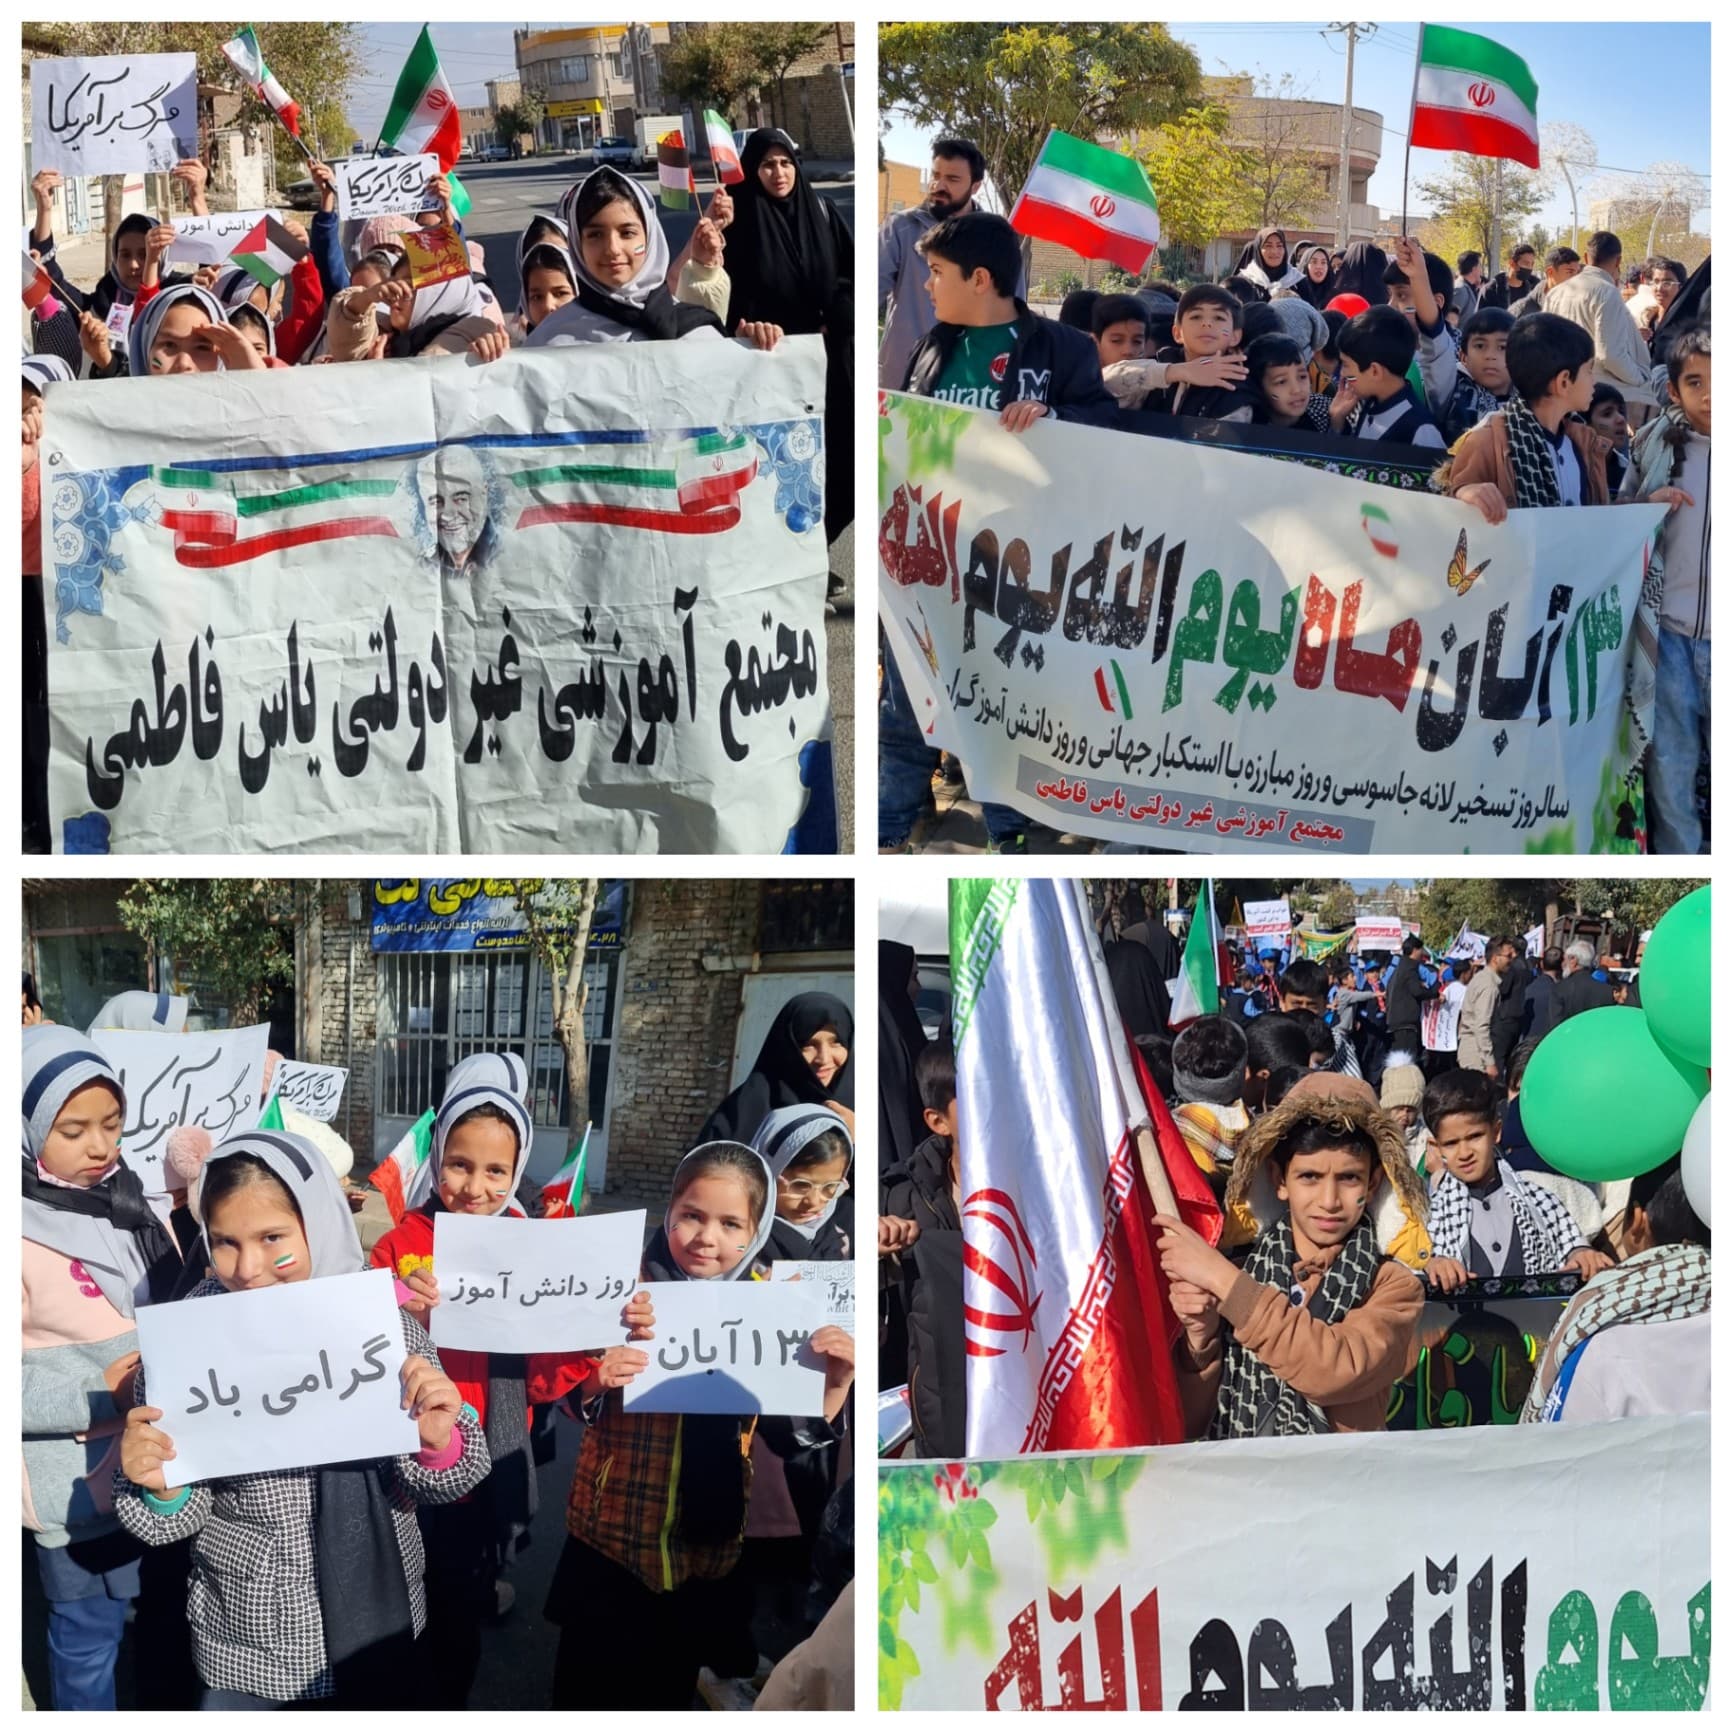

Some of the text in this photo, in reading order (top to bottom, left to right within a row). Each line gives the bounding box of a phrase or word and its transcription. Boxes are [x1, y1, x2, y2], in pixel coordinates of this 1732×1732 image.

[48, 66, 180, 152] مرگ بر آمریکا
[397, 161, 427, 199] رگ
[878, 480, 962, 604] الله
[963, 528, 1073, 673] یوم
[1063, 522, 1187, 665] الله
[1161, 568, 1302, 715] یوم
[1293, 572, 1423, 713] ماه
[86, 585, 818, 810] مجتمع آموزشی غیر دولتی یاس فاطمی
[946, 667, 981, 712] گرا
[974, 687, 1008, 725] آموز
[1006, 702, 1053, 744] دانش
[1088, 724, 1151, 776] جهانی
[1150, 731, 1225, 780] استکبار
[1244, 749, 1294, 795] مبارزه
[1035, 776, 1345, 846] مجتمع آموزشی غیر دولتی یاس فاطمی
[1332, 769, 1419, 816] جاسوسی
[1418, 781, 1456, 812] لانه
[1449, 782, 1518, 824] تسخیر
[1512, 781, 1570, 828] سالروز
[202, 1063, 251, 1141] مرگ
[449, 1270, 636, 1306] روز دانش آموز
[657, 1318, 808, 1376] ۱۳ آبان
[186, 1333, 391, 1417] گرامی باد
